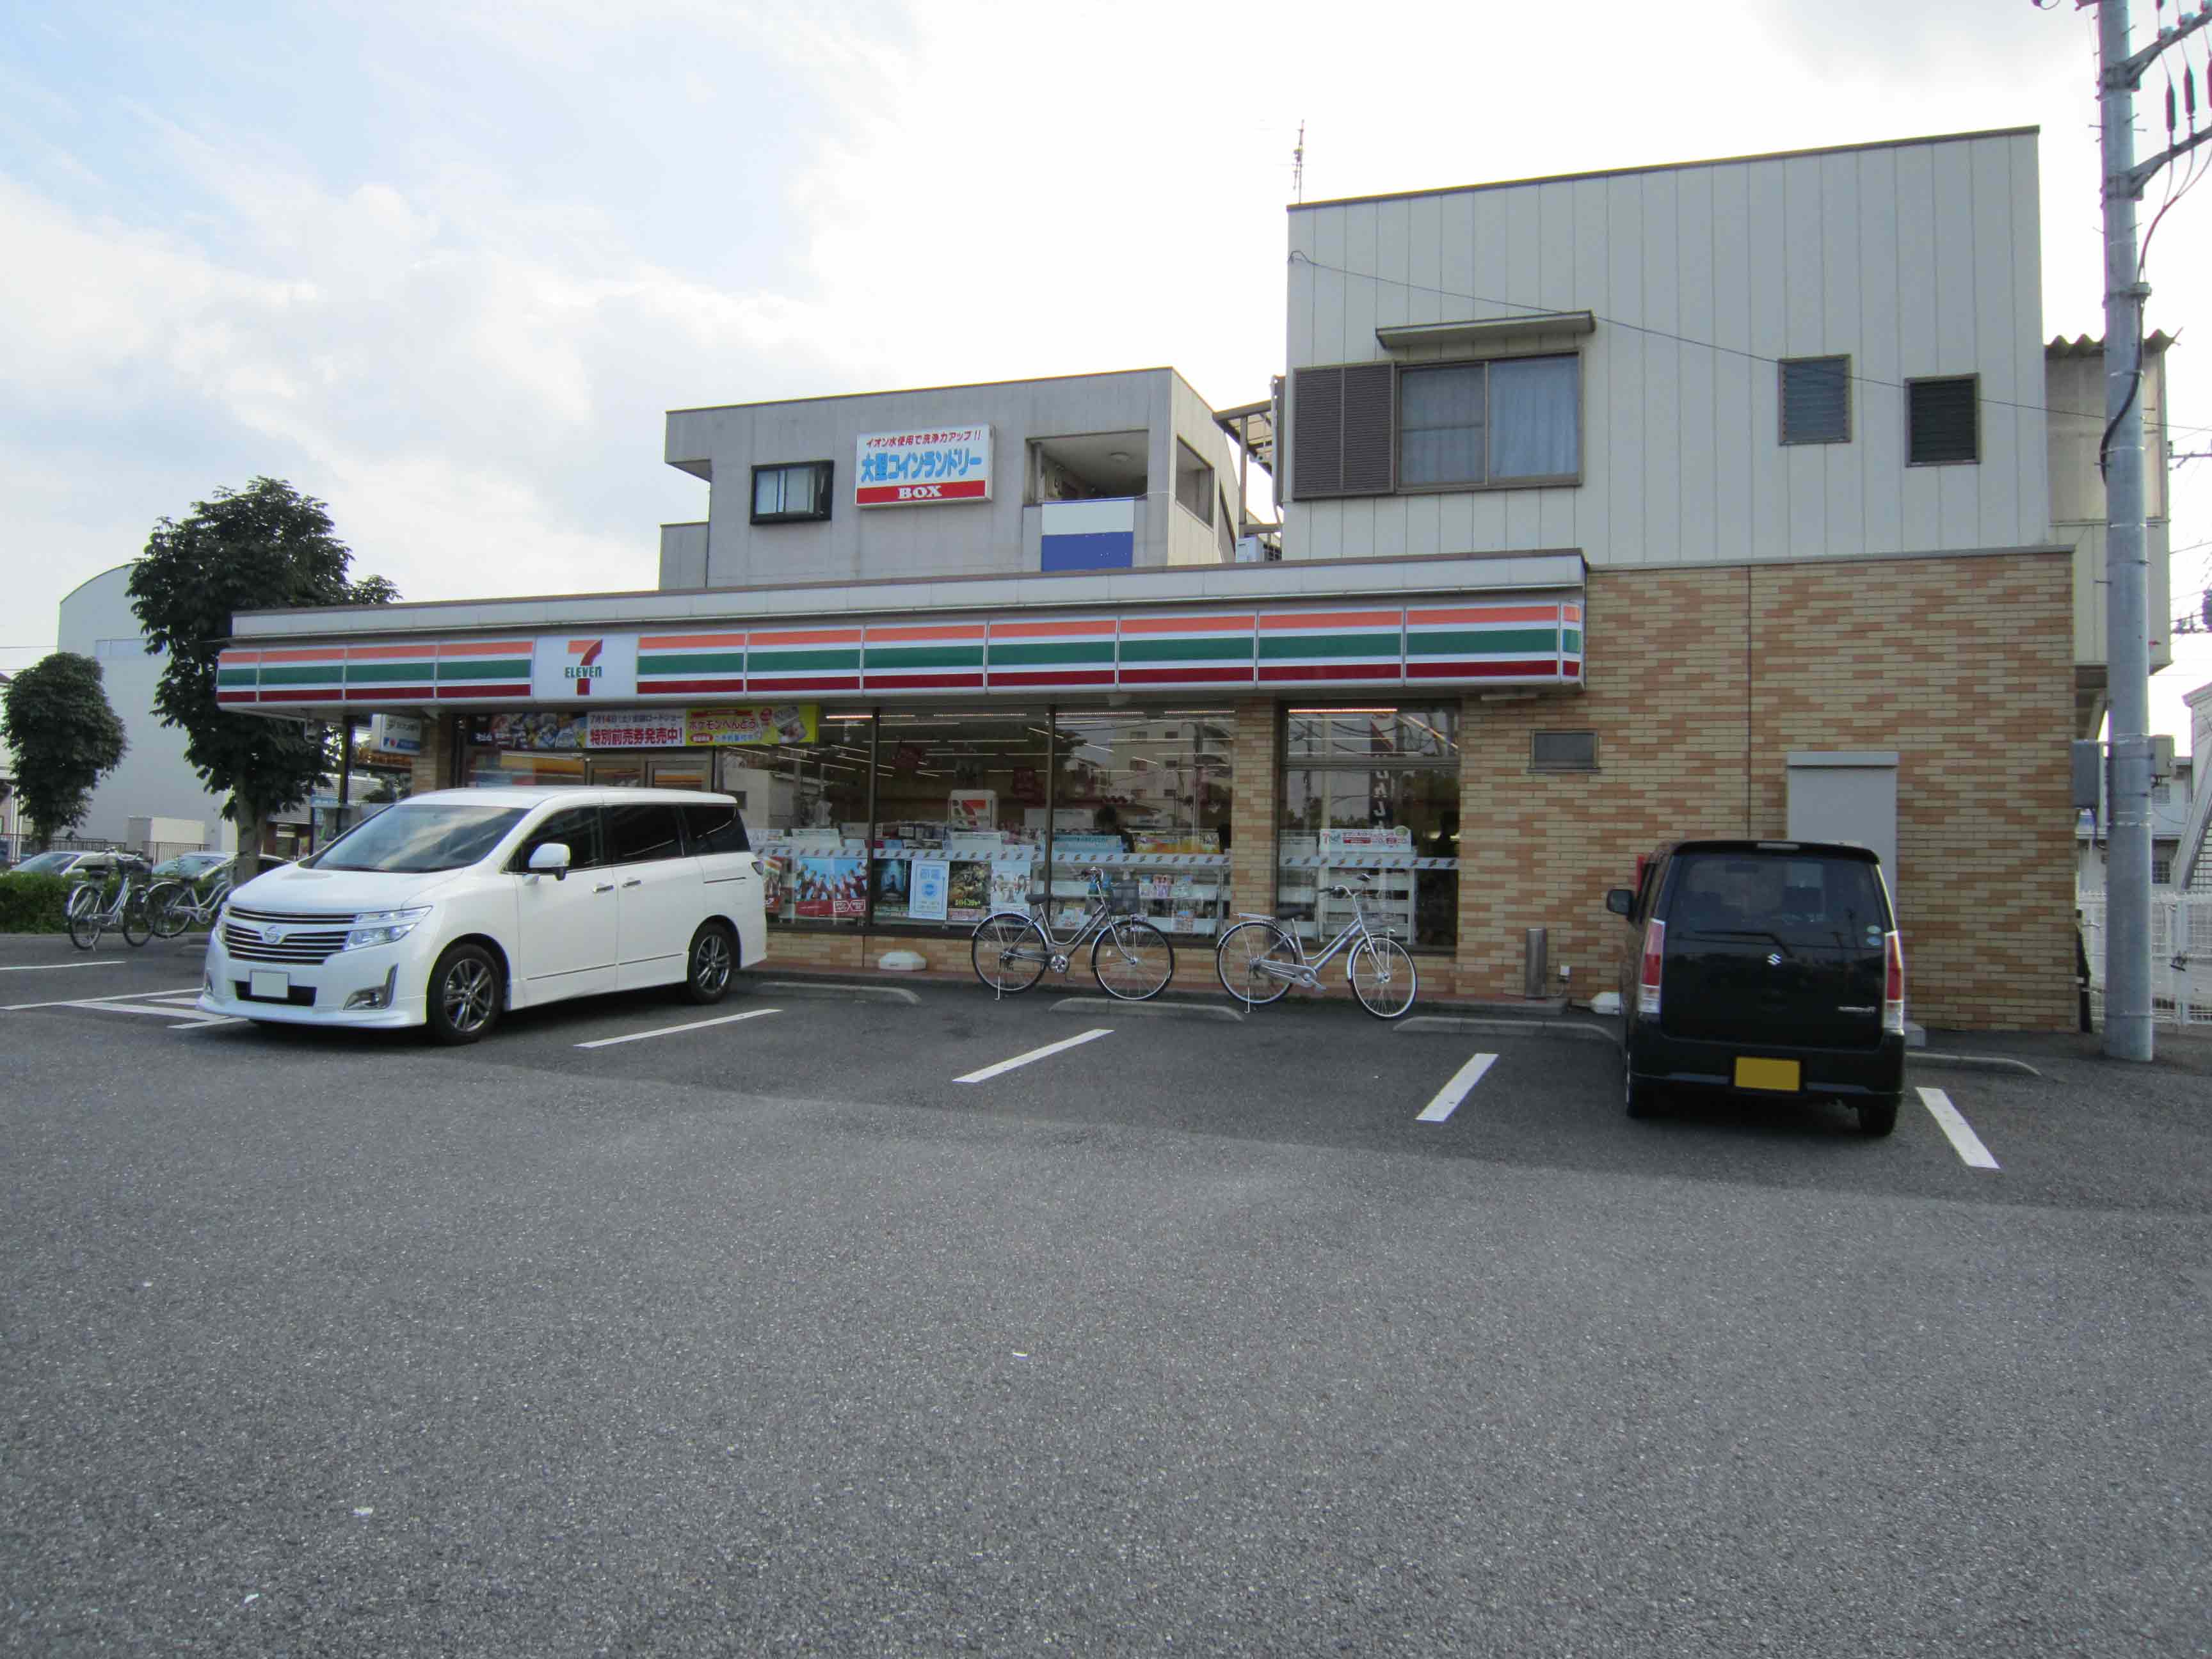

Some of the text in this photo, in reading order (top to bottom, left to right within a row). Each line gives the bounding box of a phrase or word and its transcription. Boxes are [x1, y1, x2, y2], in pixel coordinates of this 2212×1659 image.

[861, 448, 982, 482] 大型コインランドリー
[898, 485, 942, 499] BOX
[567, 639, 604, 695] 7
[590, 726, 682, 745] 特別前売券発売中!
